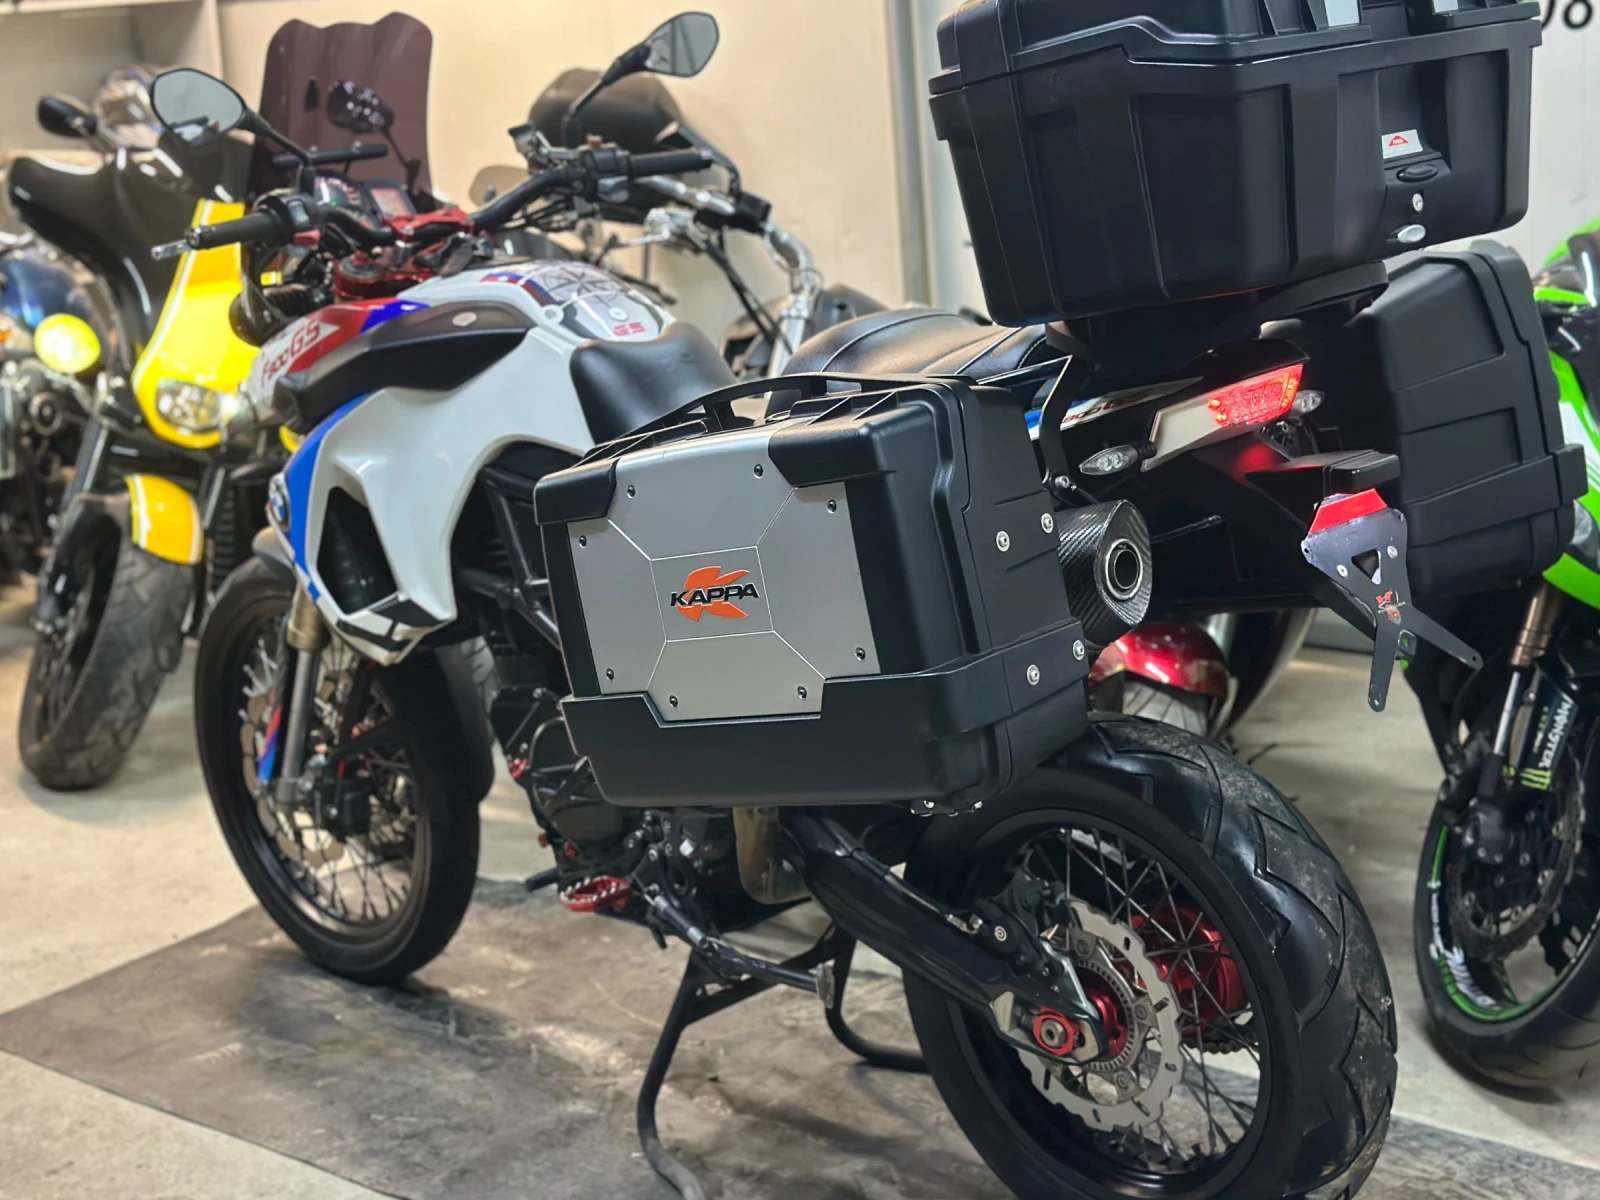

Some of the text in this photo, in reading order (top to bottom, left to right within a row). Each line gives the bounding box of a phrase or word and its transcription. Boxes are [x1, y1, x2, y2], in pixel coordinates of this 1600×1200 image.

[613, 321, 646, 337] GS
[670, 583, 760, 606] KAPPA
[1537, 691, 1575, 769] MONSTER
